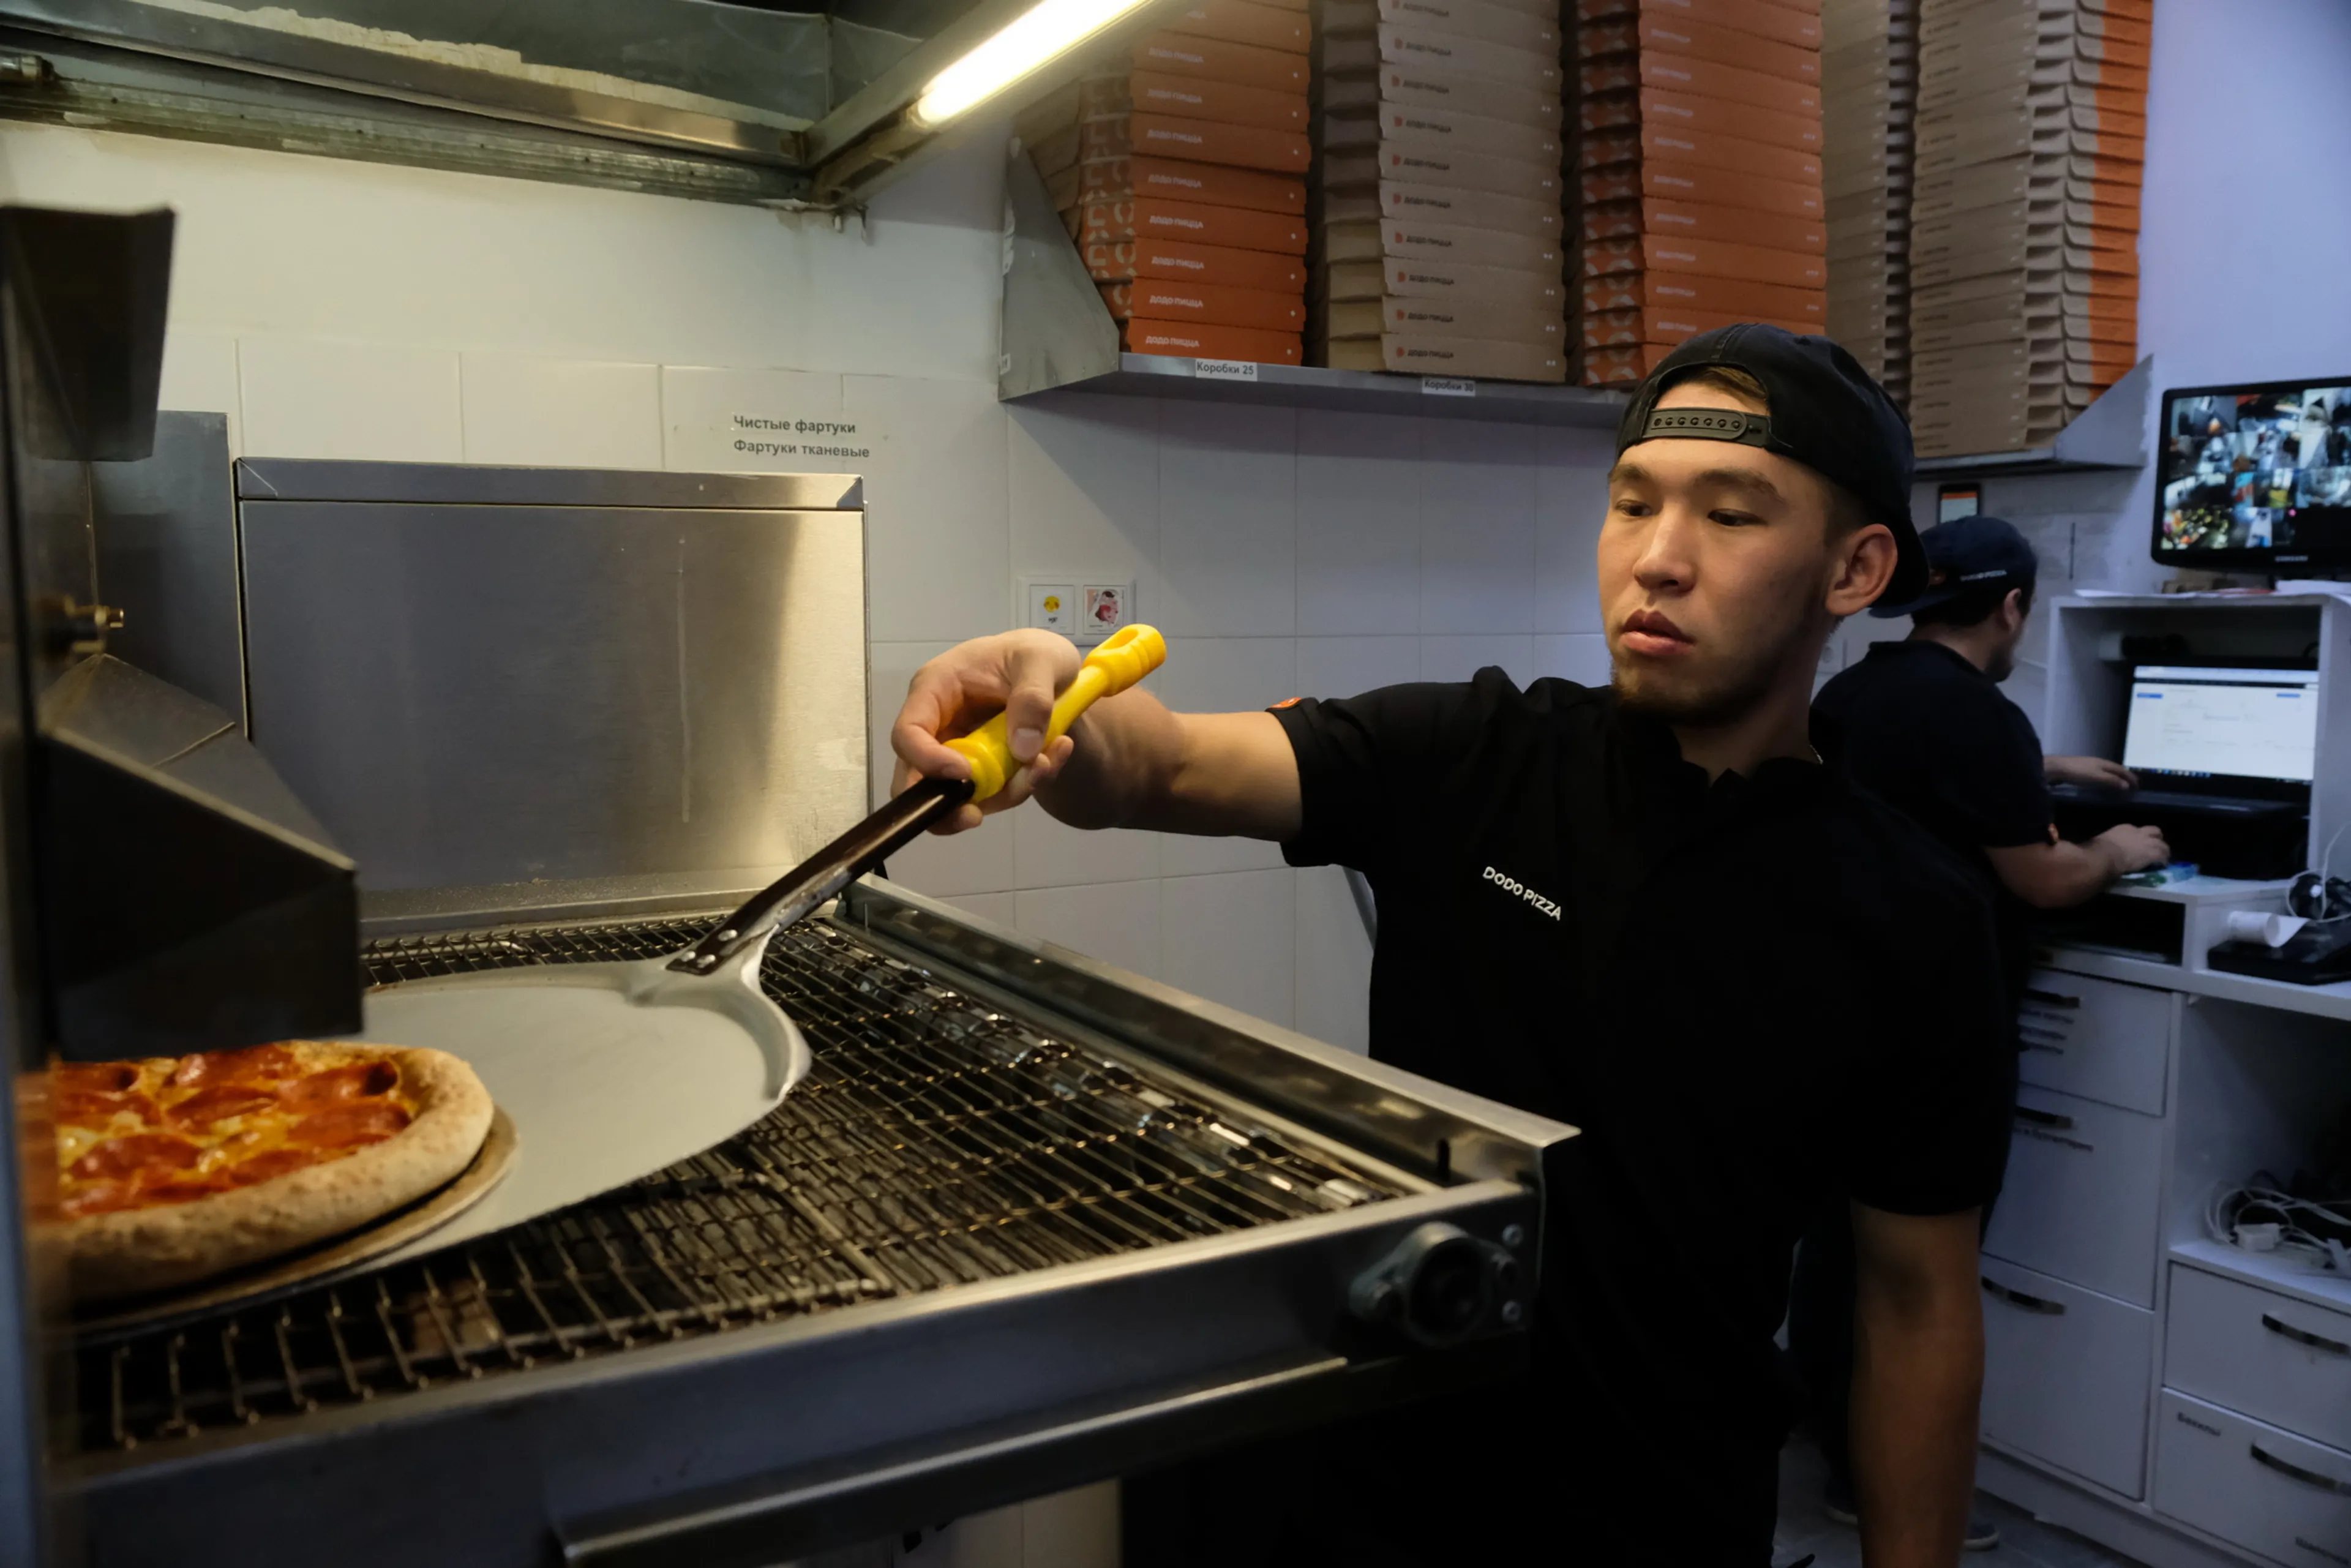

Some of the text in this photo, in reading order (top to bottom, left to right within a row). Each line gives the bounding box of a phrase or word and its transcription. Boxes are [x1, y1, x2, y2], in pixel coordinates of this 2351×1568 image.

[1149, 295, 1203, 308] ДОДО ПИЦЦА
[1146, 336, 1199, 347] ДОДО ПИЦЦА
[1196, 362, 1254, 375] Коробки 25
[734, 415, 856, 435] Чистые фартуки
[734, 439, 869, 458] Фартуки тканевые
[1482, 866, 1561, 921] DODO PIZZA
